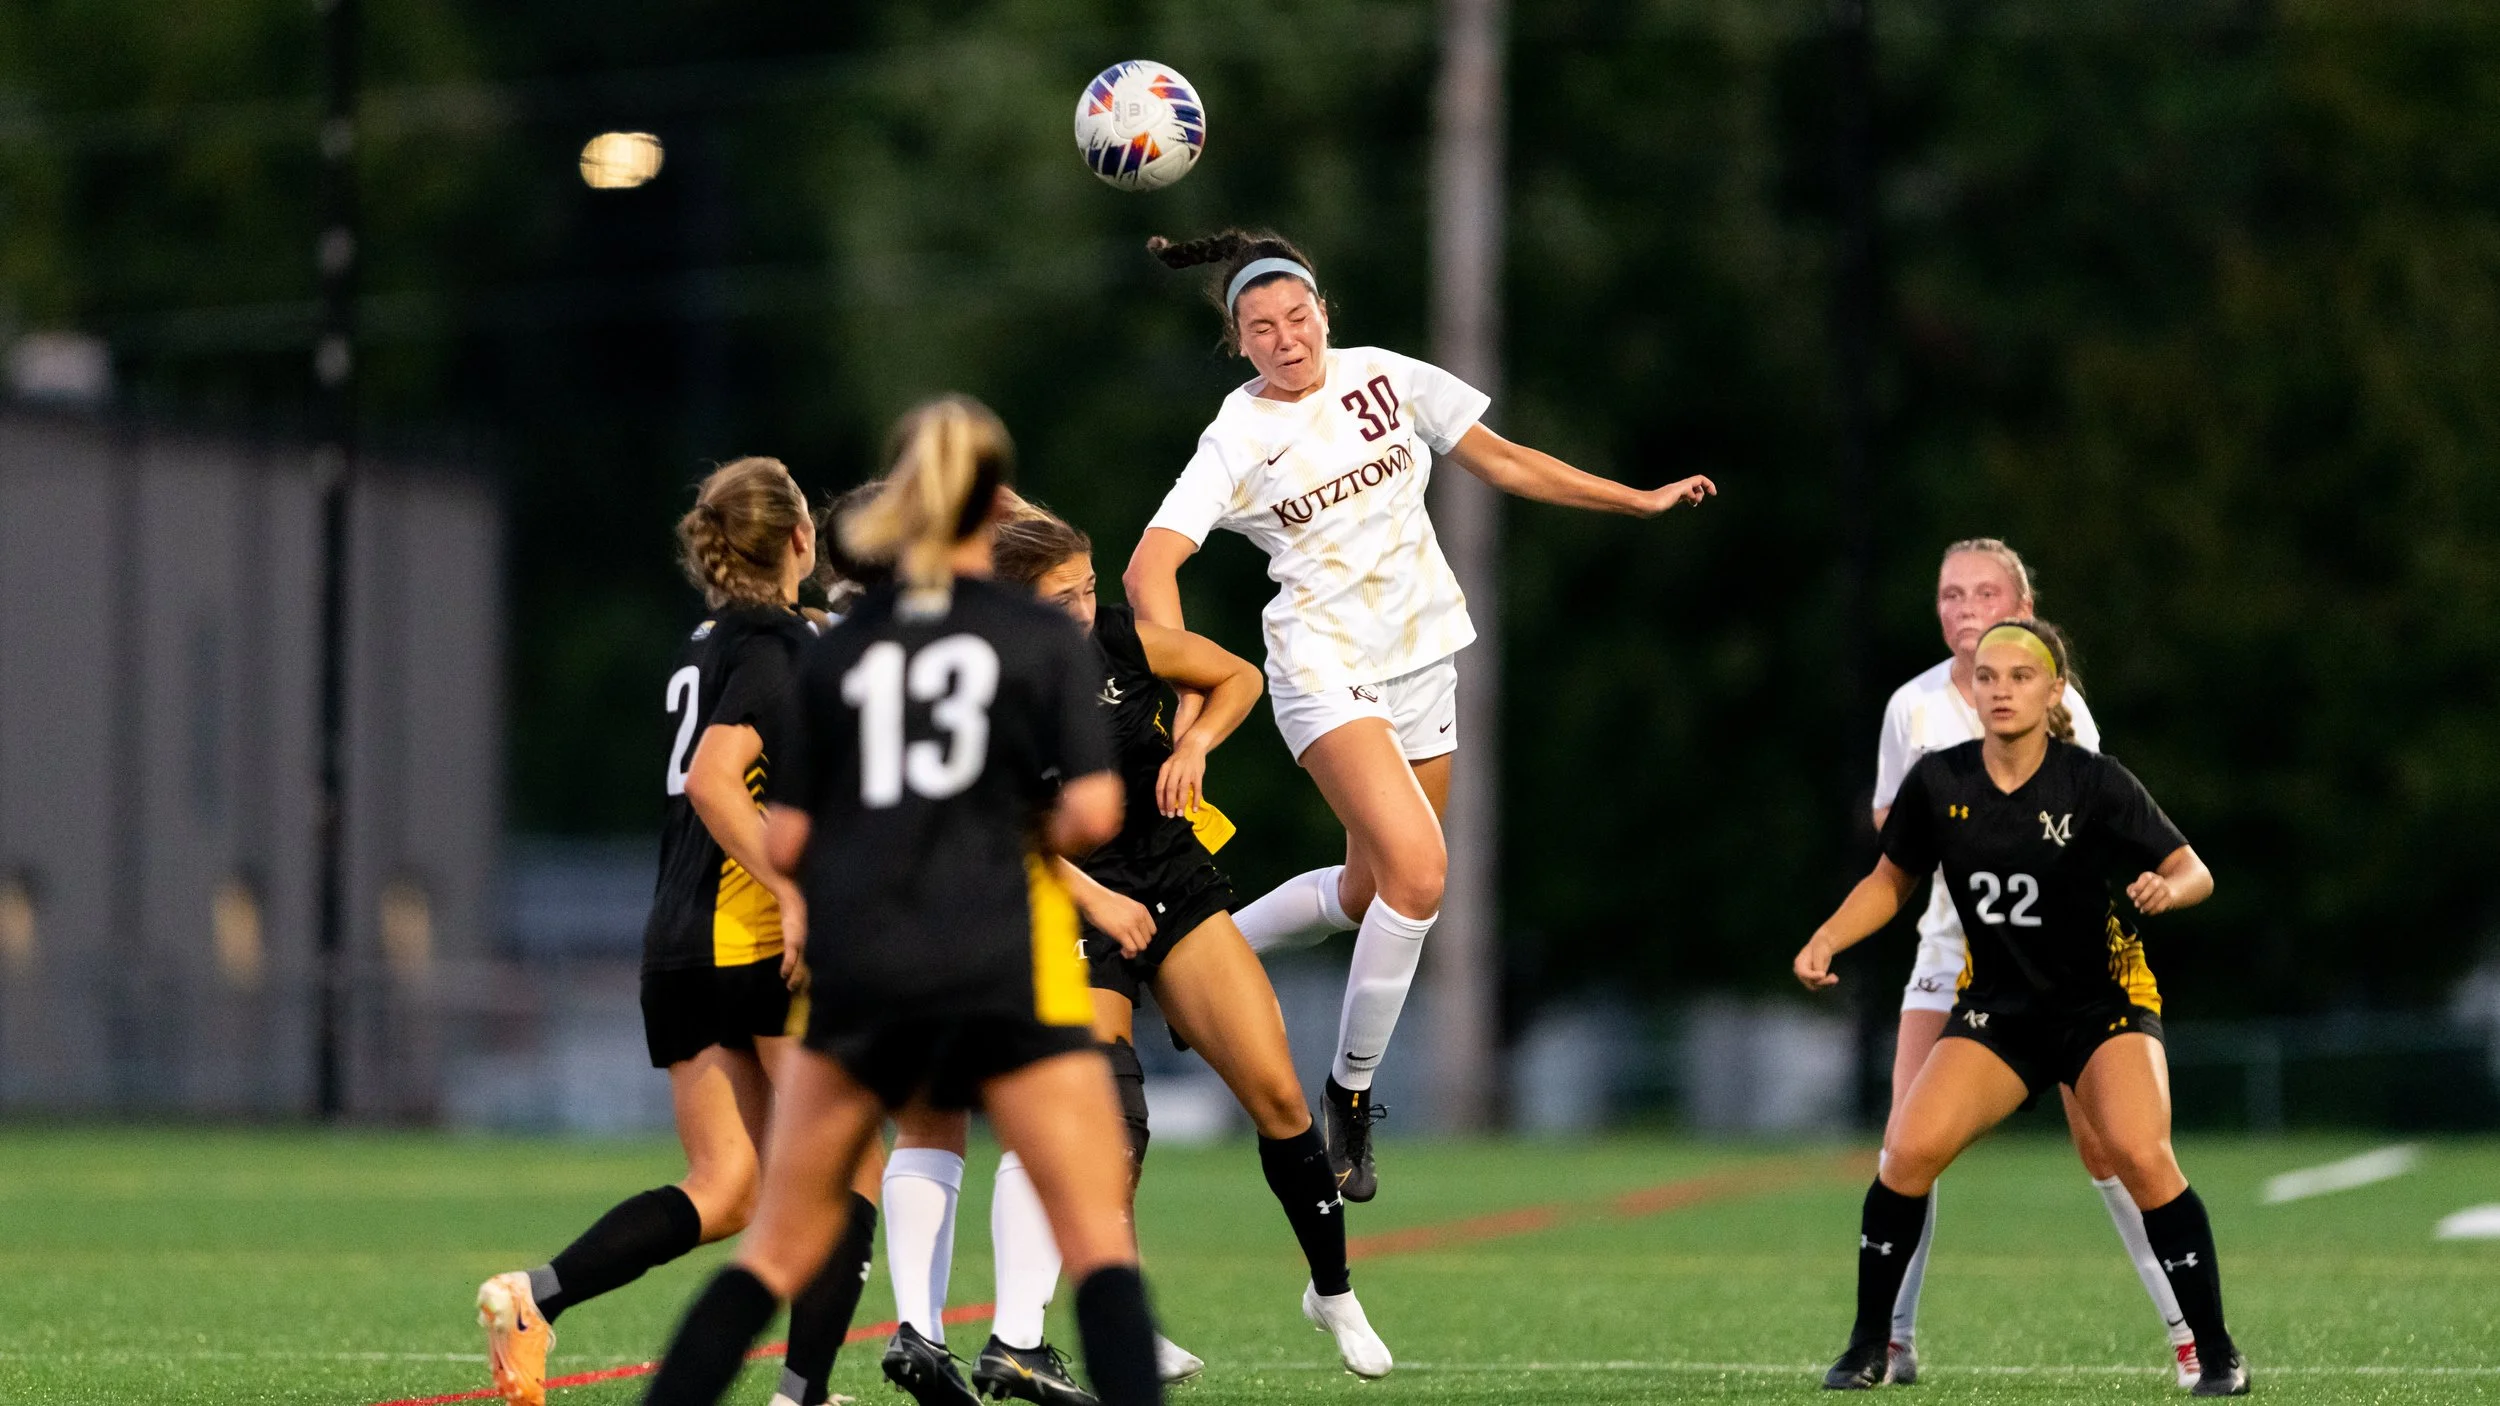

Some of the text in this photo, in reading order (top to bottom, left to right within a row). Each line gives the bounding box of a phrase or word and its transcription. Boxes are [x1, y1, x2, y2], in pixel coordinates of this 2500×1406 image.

[1341, 374, 1401, 442] 30
[1269, 438, 1416, 528] KUTZTOWN
[666, 665, 700, 796] 2
[841, 632, 1000, 809] 13
[1968, 871, 2043, 927] 22
